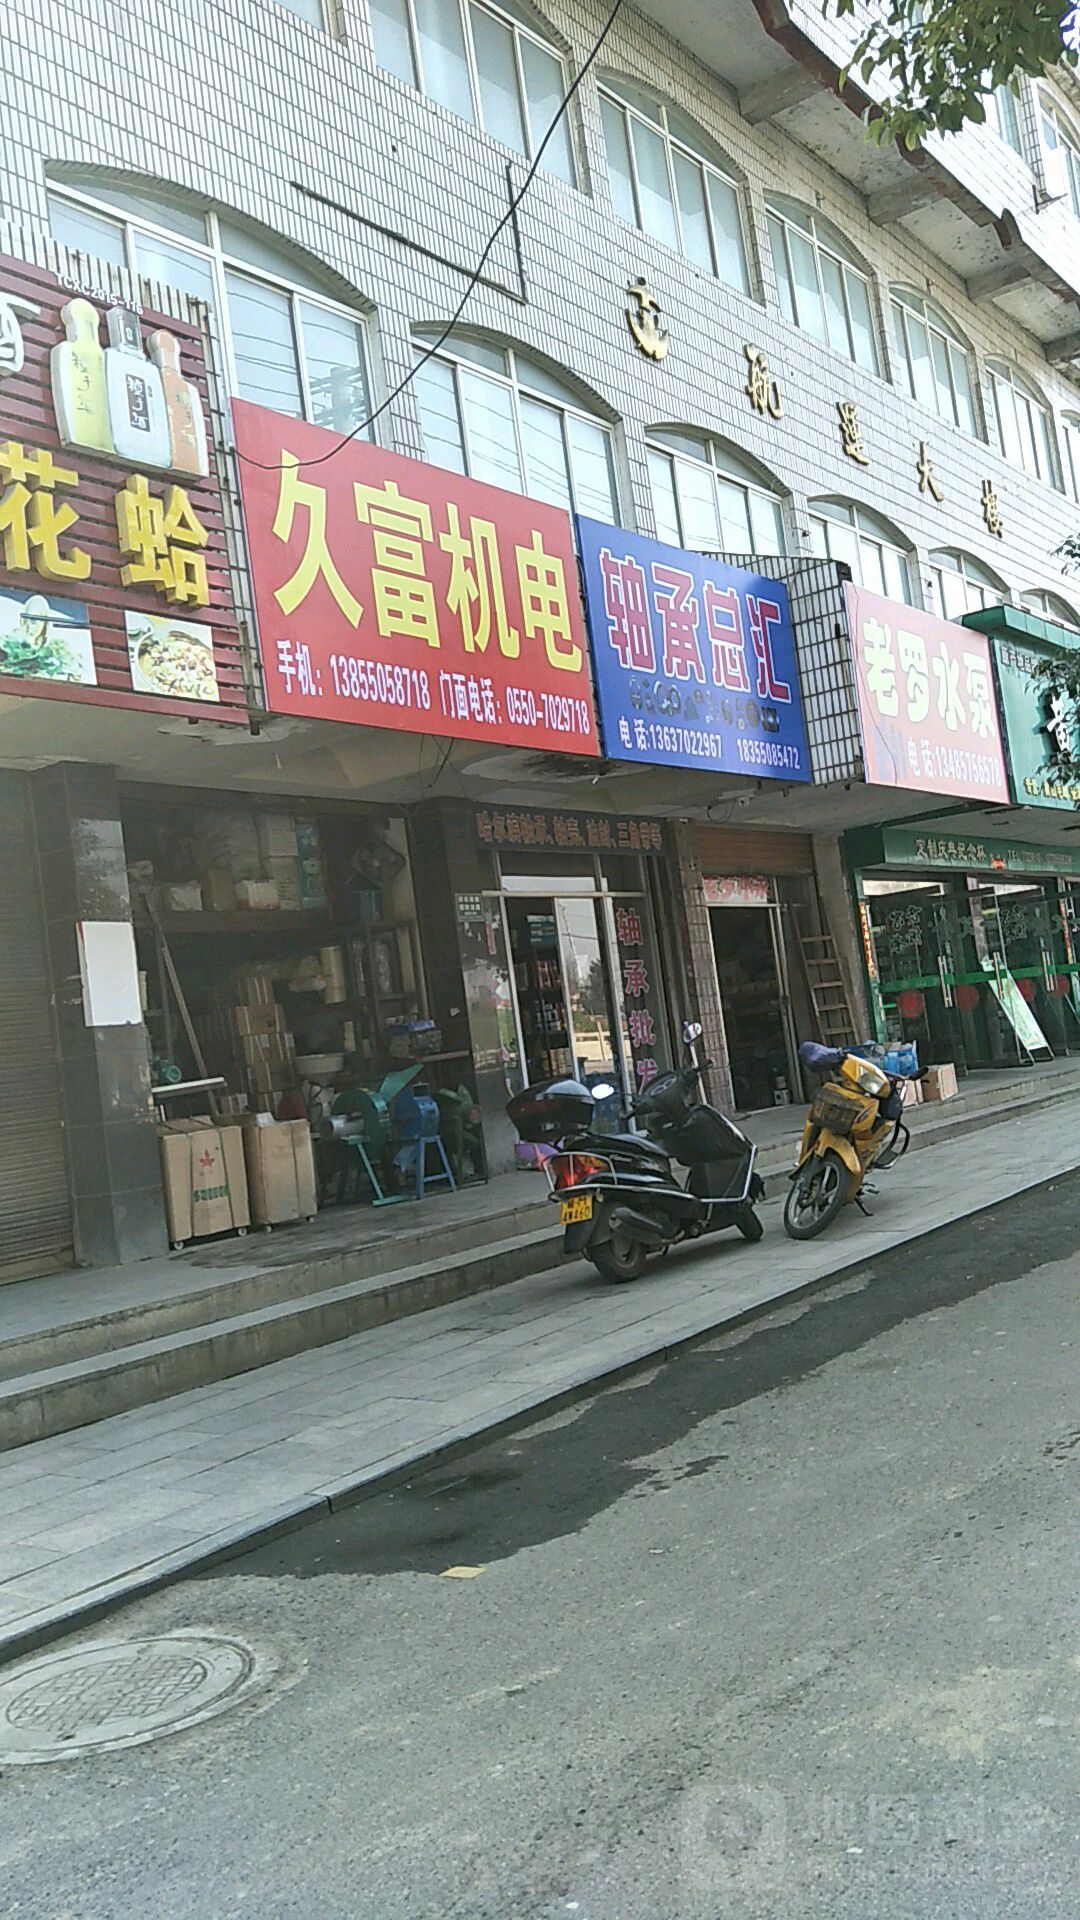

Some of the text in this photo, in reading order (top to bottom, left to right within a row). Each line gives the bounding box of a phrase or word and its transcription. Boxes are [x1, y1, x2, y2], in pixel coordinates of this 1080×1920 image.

[271, 448, 583, 672] 久富机电
[600, 547, 792, 704] 轴承总汇
[862, 616, 997, 739] 老罗水泵
[329, 654, 431, 711] 13855058718
[506, 685, 591, 736] 0550-7029718
[736, 737, 801, 771] 18355085472
